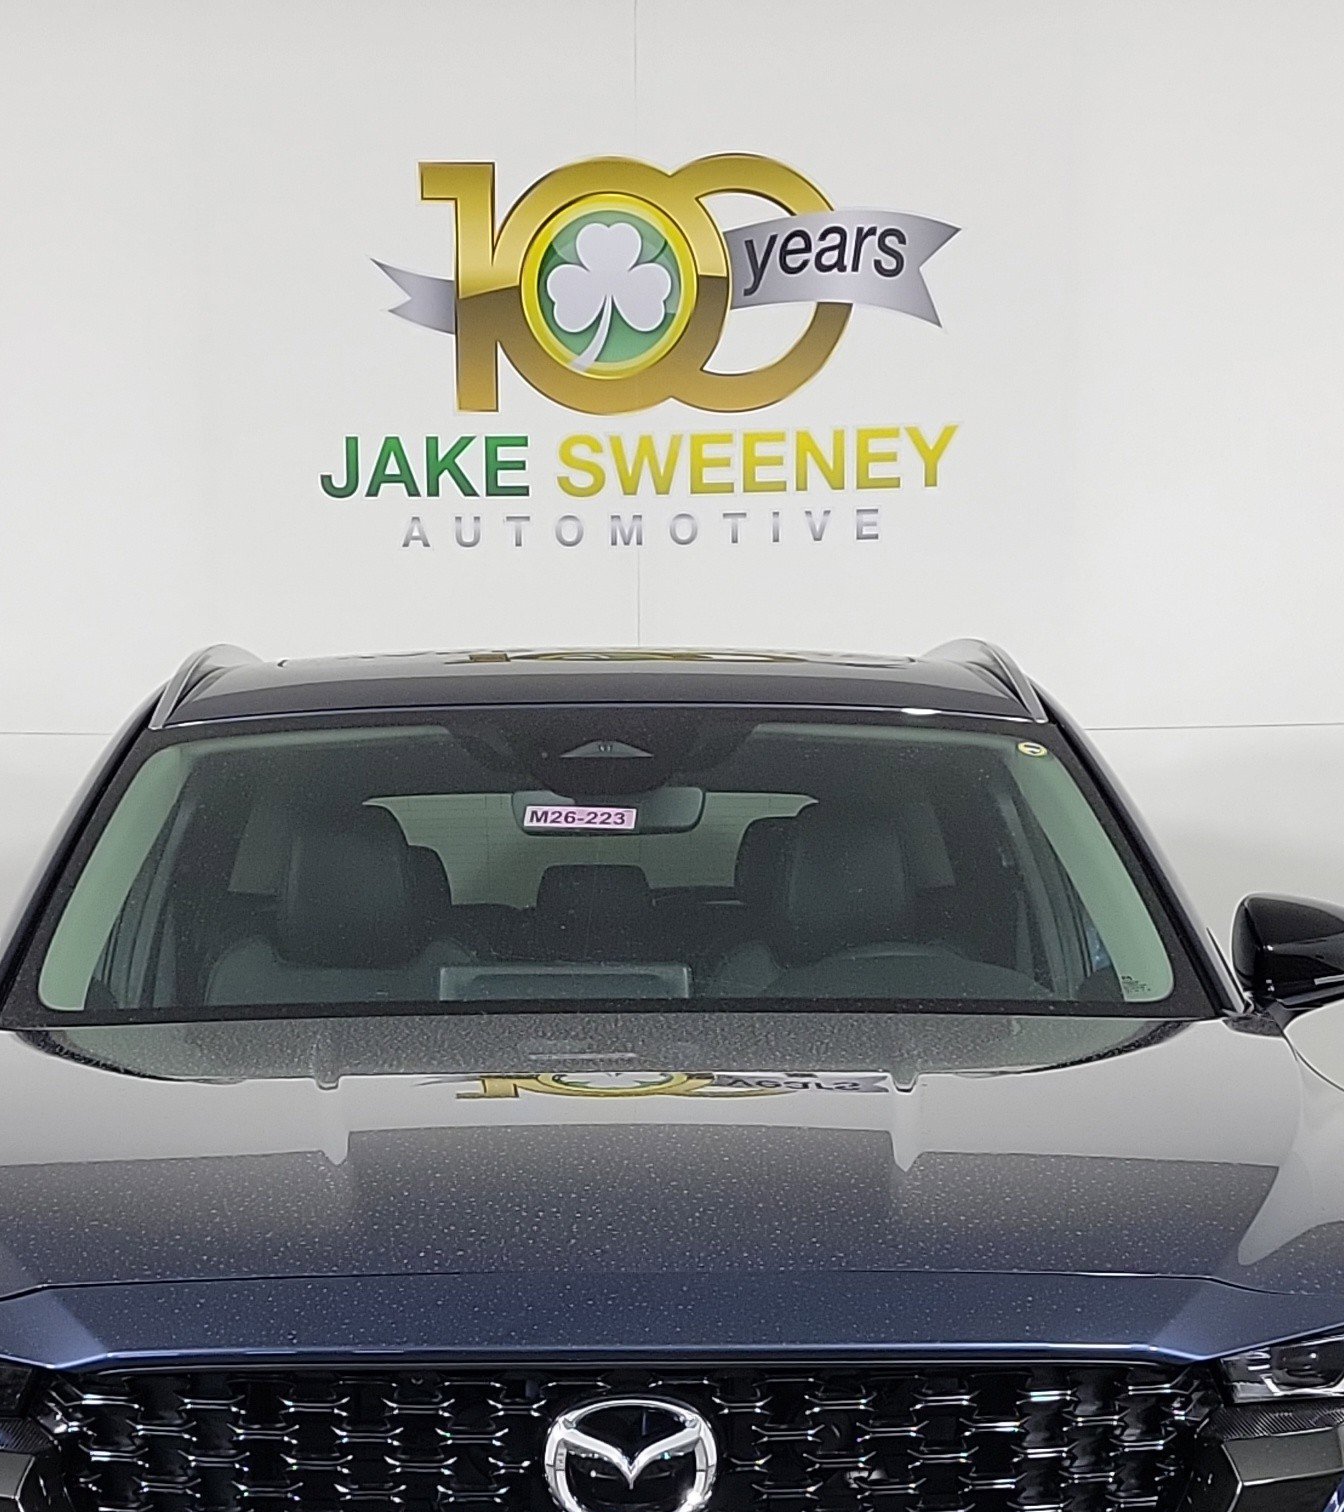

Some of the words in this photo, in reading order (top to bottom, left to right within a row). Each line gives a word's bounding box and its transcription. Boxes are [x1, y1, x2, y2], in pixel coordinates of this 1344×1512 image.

[419, 152, 852, 415] 100
[743, 224, 907, 297] years
[320, 435, 529, 499] JAKE
[557, 425, 958, 497] SWEENEY
[402, 508, 879, 548] AUTOMOTIVE
[529, 809, 626, 825] M26-223
